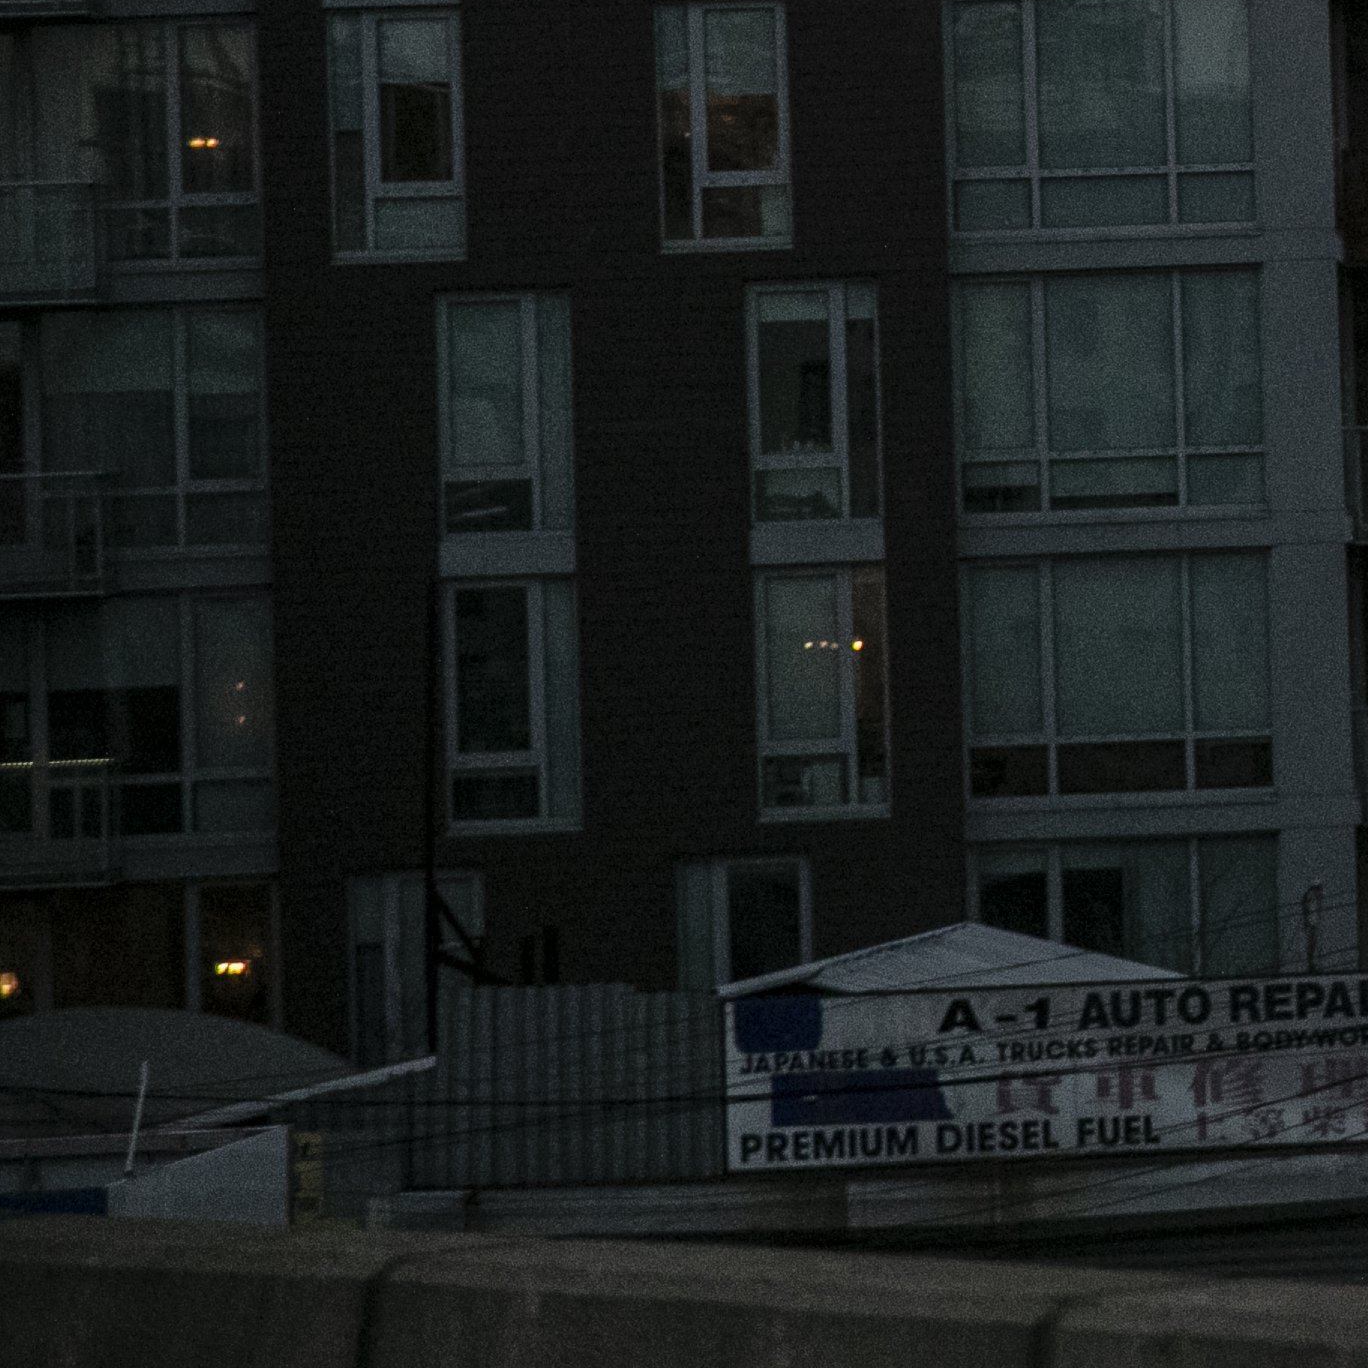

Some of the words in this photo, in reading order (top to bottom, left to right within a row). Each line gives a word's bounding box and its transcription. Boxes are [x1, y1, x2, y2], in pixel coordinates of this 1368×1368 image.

[1078, 986, 1212, 1030] AUTO
[740, 1048, 868, 1074] JAPANESE
[881, 1046, 897, 1066] &
[997, 1037, 1099, 1062] TRUCKS
[1107, 1033, 1195, 1056] REPAIR
[1206, 1033, 1224, 1052] &
[739, 1128, 920, 1163] PREMIUM
[936, 1119, 1060, 1154] DIESEL
[1077, 1116, 1161, 1148] FUEL
